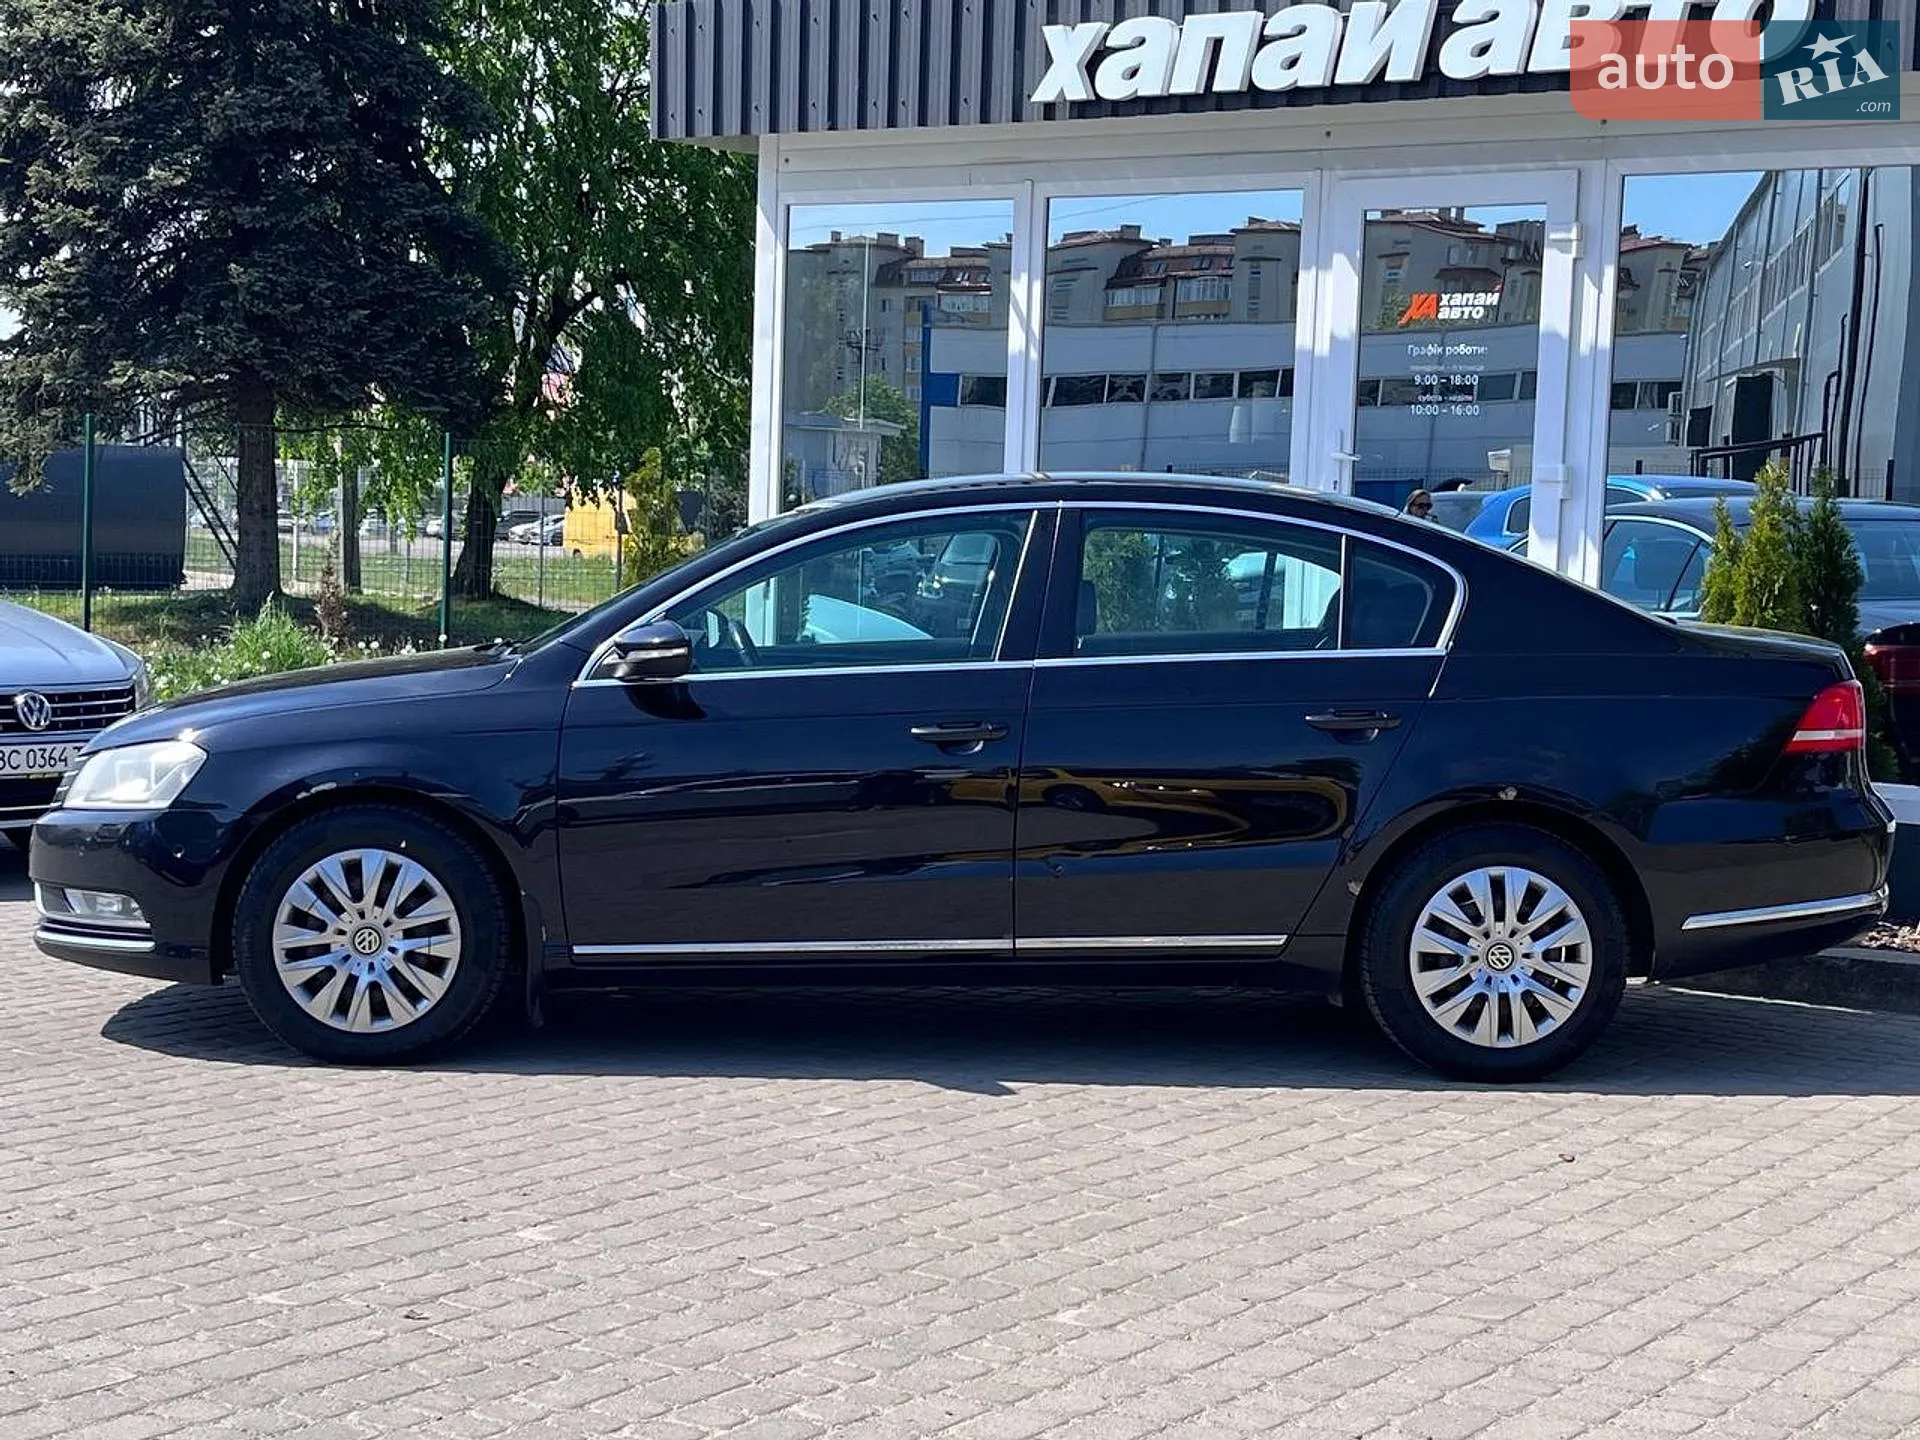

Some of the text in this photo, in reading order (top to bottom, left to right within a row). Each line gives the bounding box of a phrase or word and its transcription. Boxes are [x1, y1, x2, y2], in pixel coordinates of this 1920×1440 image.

[1437, 306, 1484, 319] авто
[1450, 374, 1479, 386] 18:00
[1411, 404, 1440, 416] 10:00
[26, 746, 68, 769] 0364
